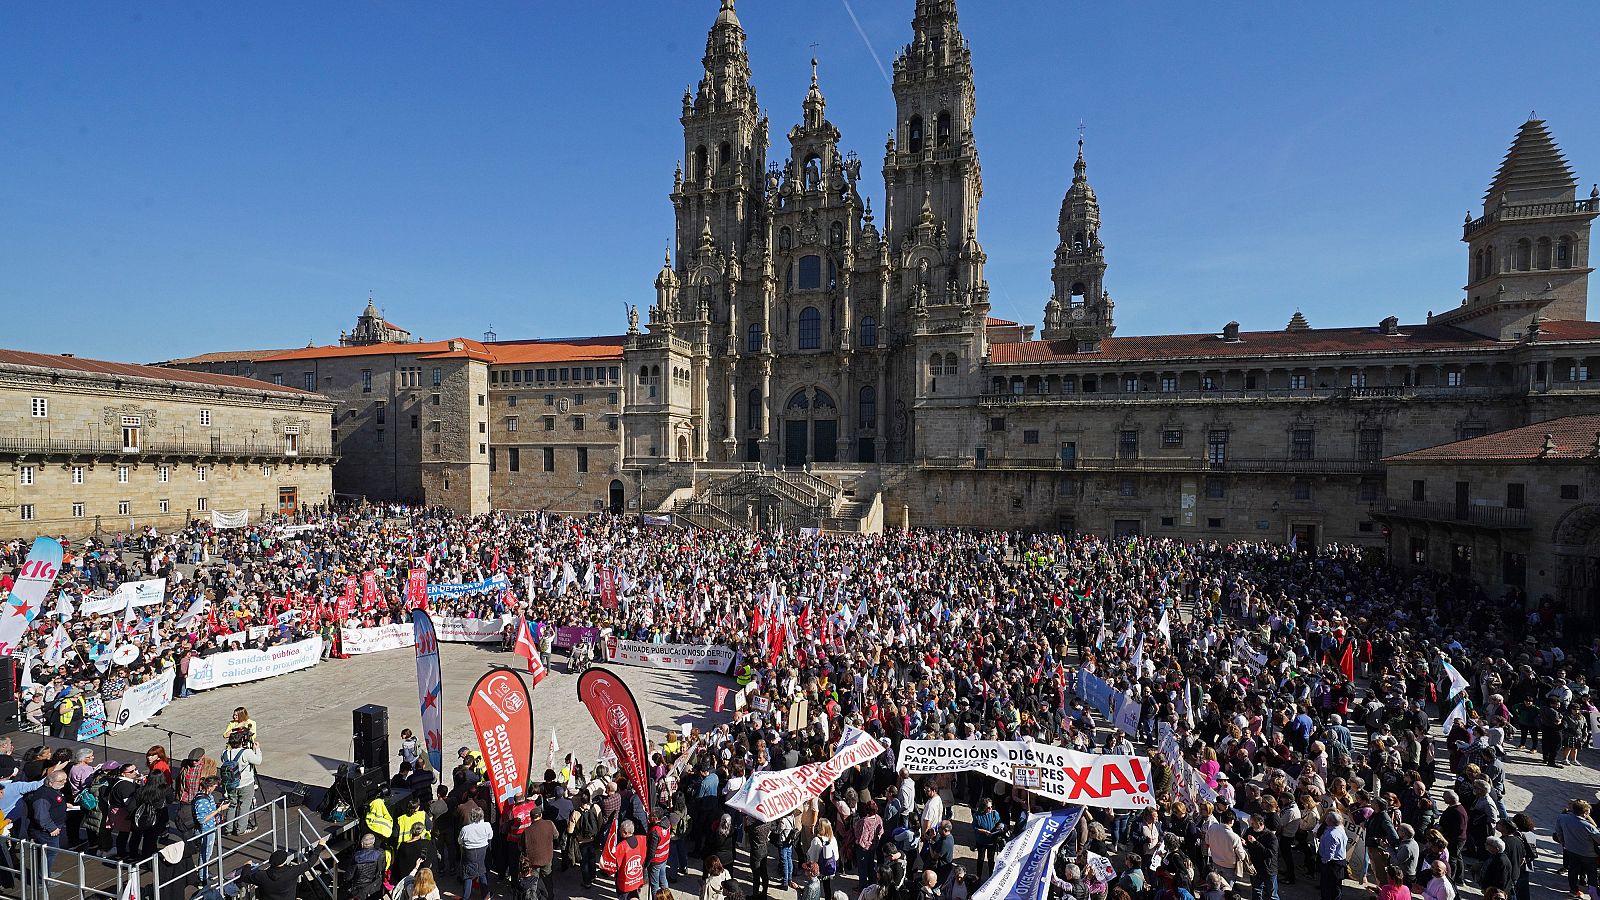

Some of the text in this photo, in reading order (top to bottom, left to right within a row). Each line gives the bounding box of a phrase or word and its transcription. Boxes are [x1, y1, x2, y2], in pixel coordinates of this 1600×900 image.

[20, 560, 56, 580] CIG
[228, 654, 271, 666] Sanidade
[271, 648, 300, 660] pública
[620, 644, 649, 654] SANIDADE
[707, 649, 732, 659] DEREITO
[222, 664, 262, 678] calidade
[904, 755, 938, 765] PARA
[906, 745, 1064, 767] CONDICIÓNS DIGNAS
[1062, 758, 1150, 799] XA!
[1046, 818, 1060, 833] DE
[627, 858, 642, 871] UGT
[1016, 870, 1036, 894] SEIXO
